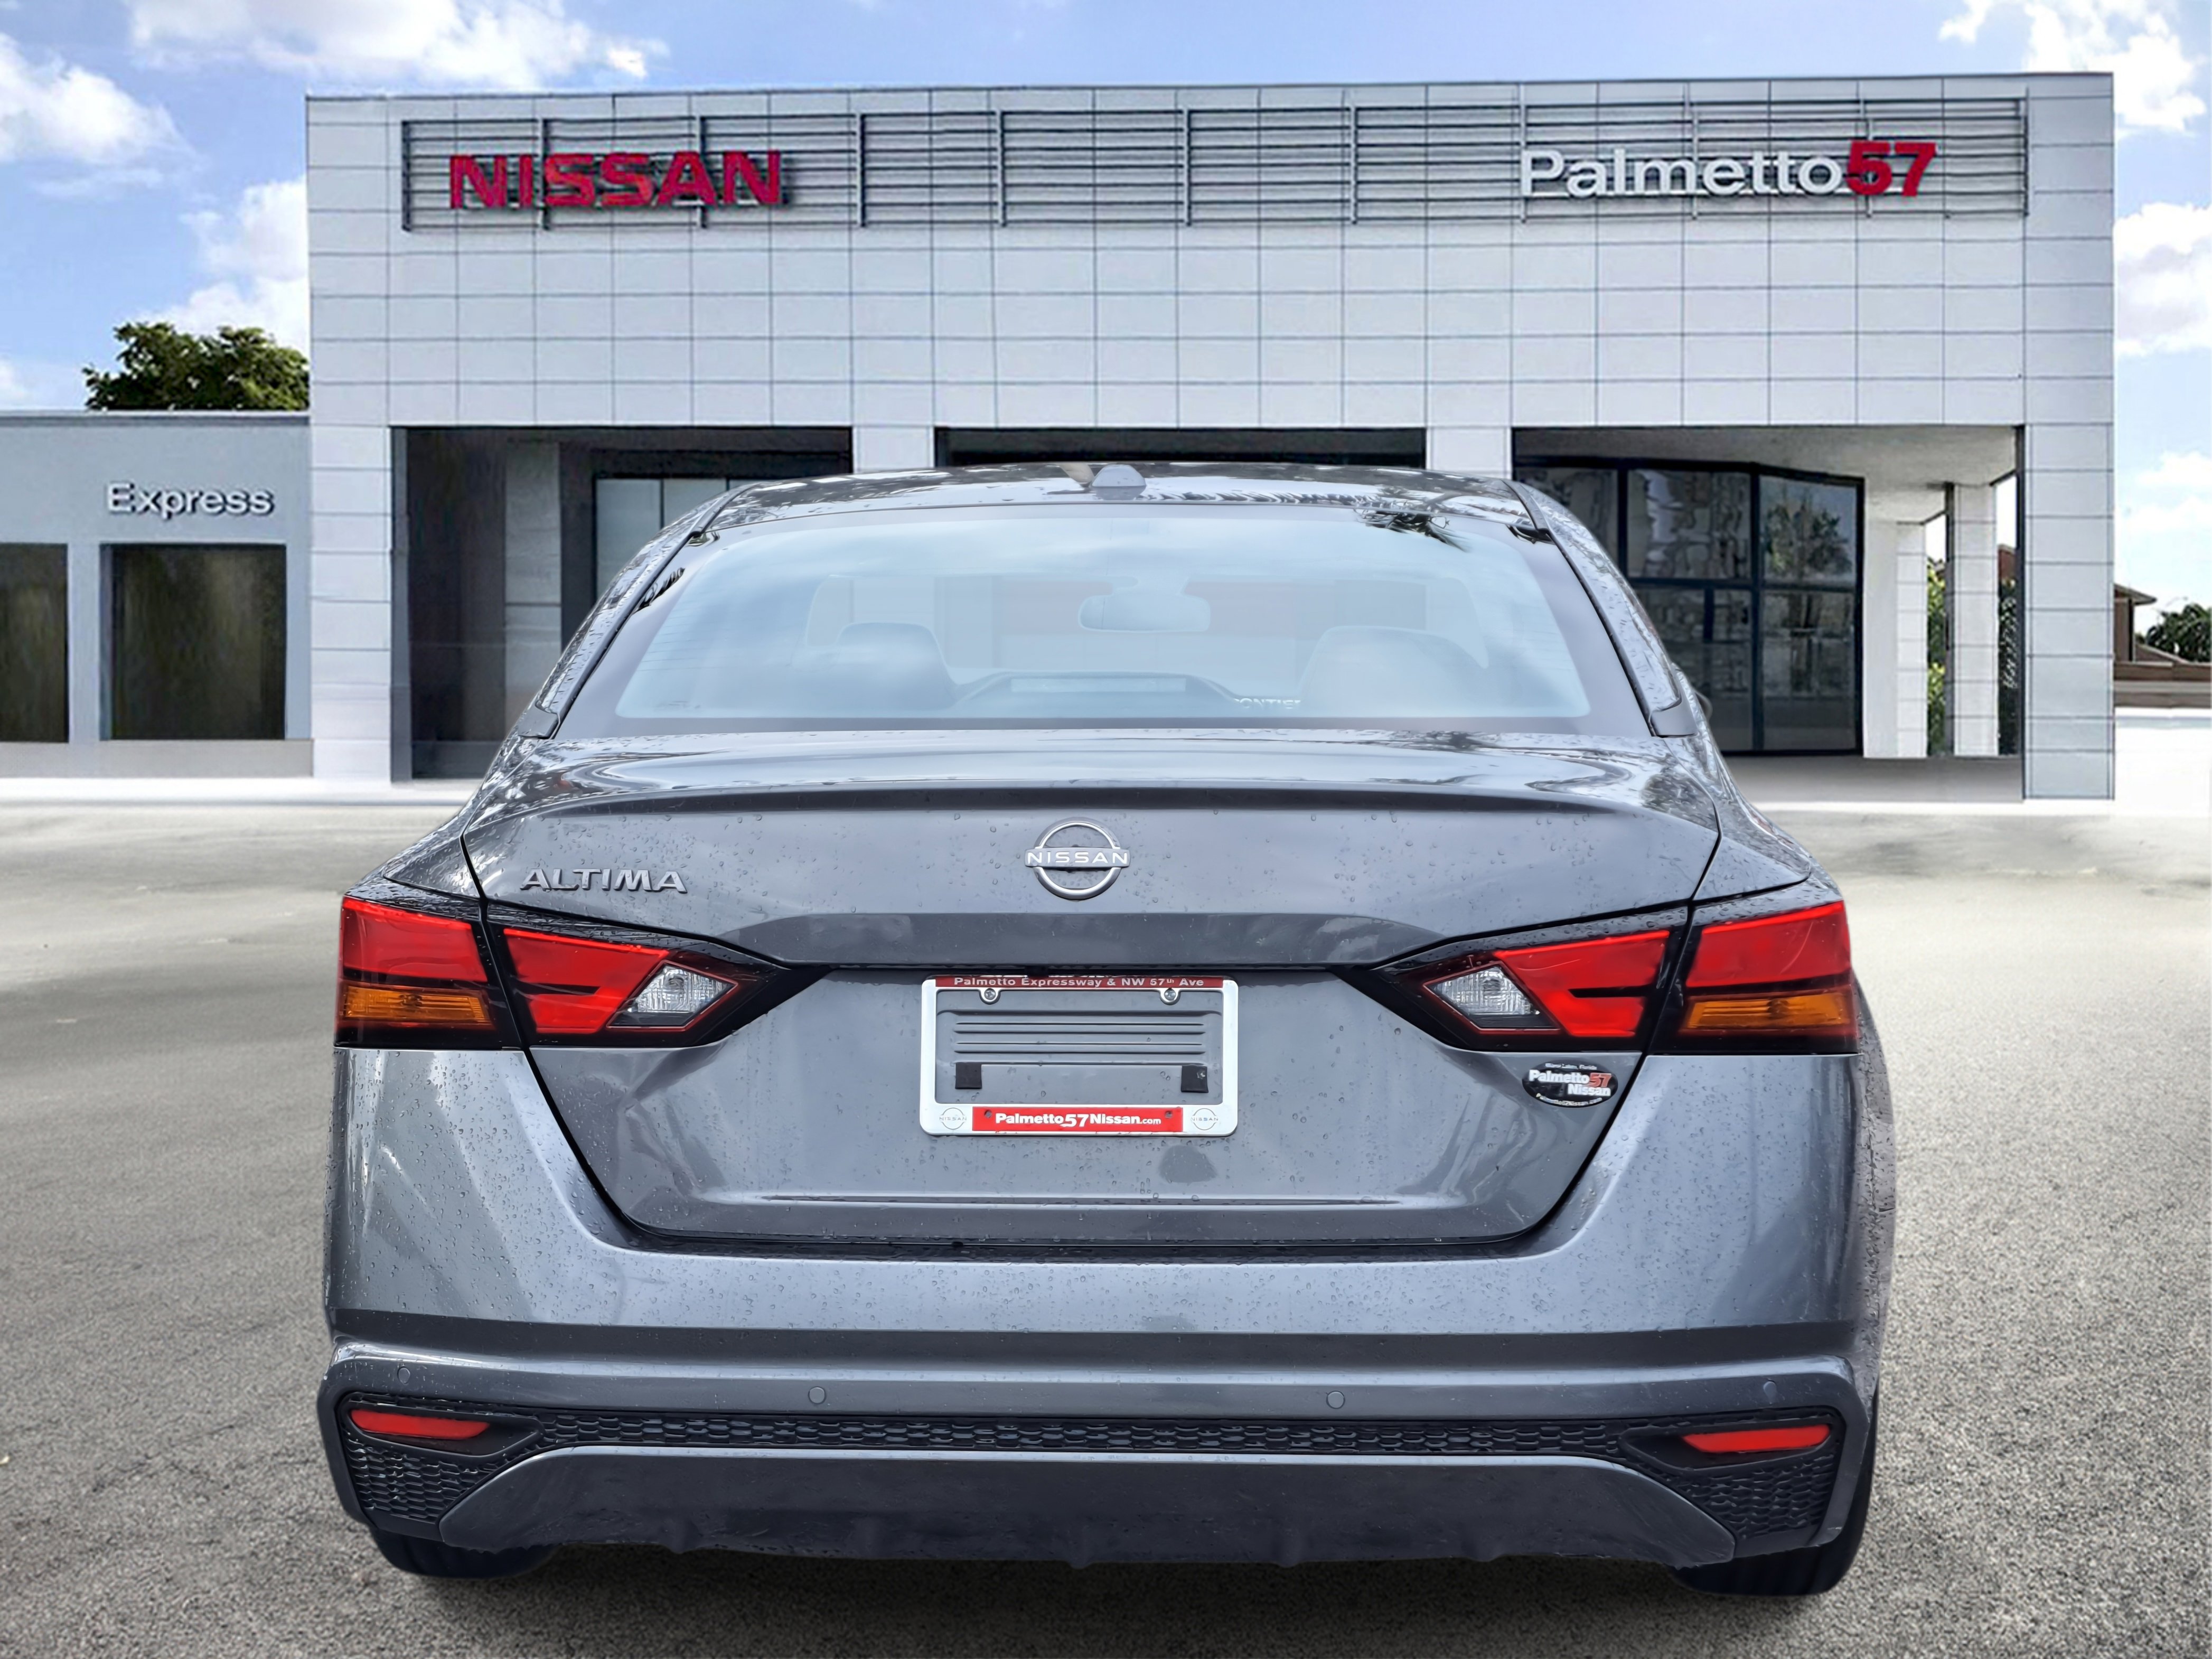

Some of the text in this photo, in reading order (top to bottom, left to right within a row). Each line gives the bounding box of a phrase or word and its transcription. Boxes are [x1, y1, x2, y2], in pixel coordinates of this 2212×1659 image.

[1520, 140, 1938, 198] Palmetto57
[450, 150, 782, 209] NISSAN
[107, 482, 275, 521] Express
[1027, 851, 1128, 865] NISSAN
[520, 868, 688, 894] ALTIMA
[953, 977, 1016, 986] Palmetto
[1021, 977, 1102, 988] Expressway
[1107, 978, 1116, 987] &
[1121, 978, 1145, 986] NW
[1179, 978, 1204, 987] Ave
[1529, 1069, 1612, 1088] Palmetto57
[1567, 1083, 1611, 1096] Nissan
[995, 1112, 1162, 1128] Palmetto57Nissan.com
